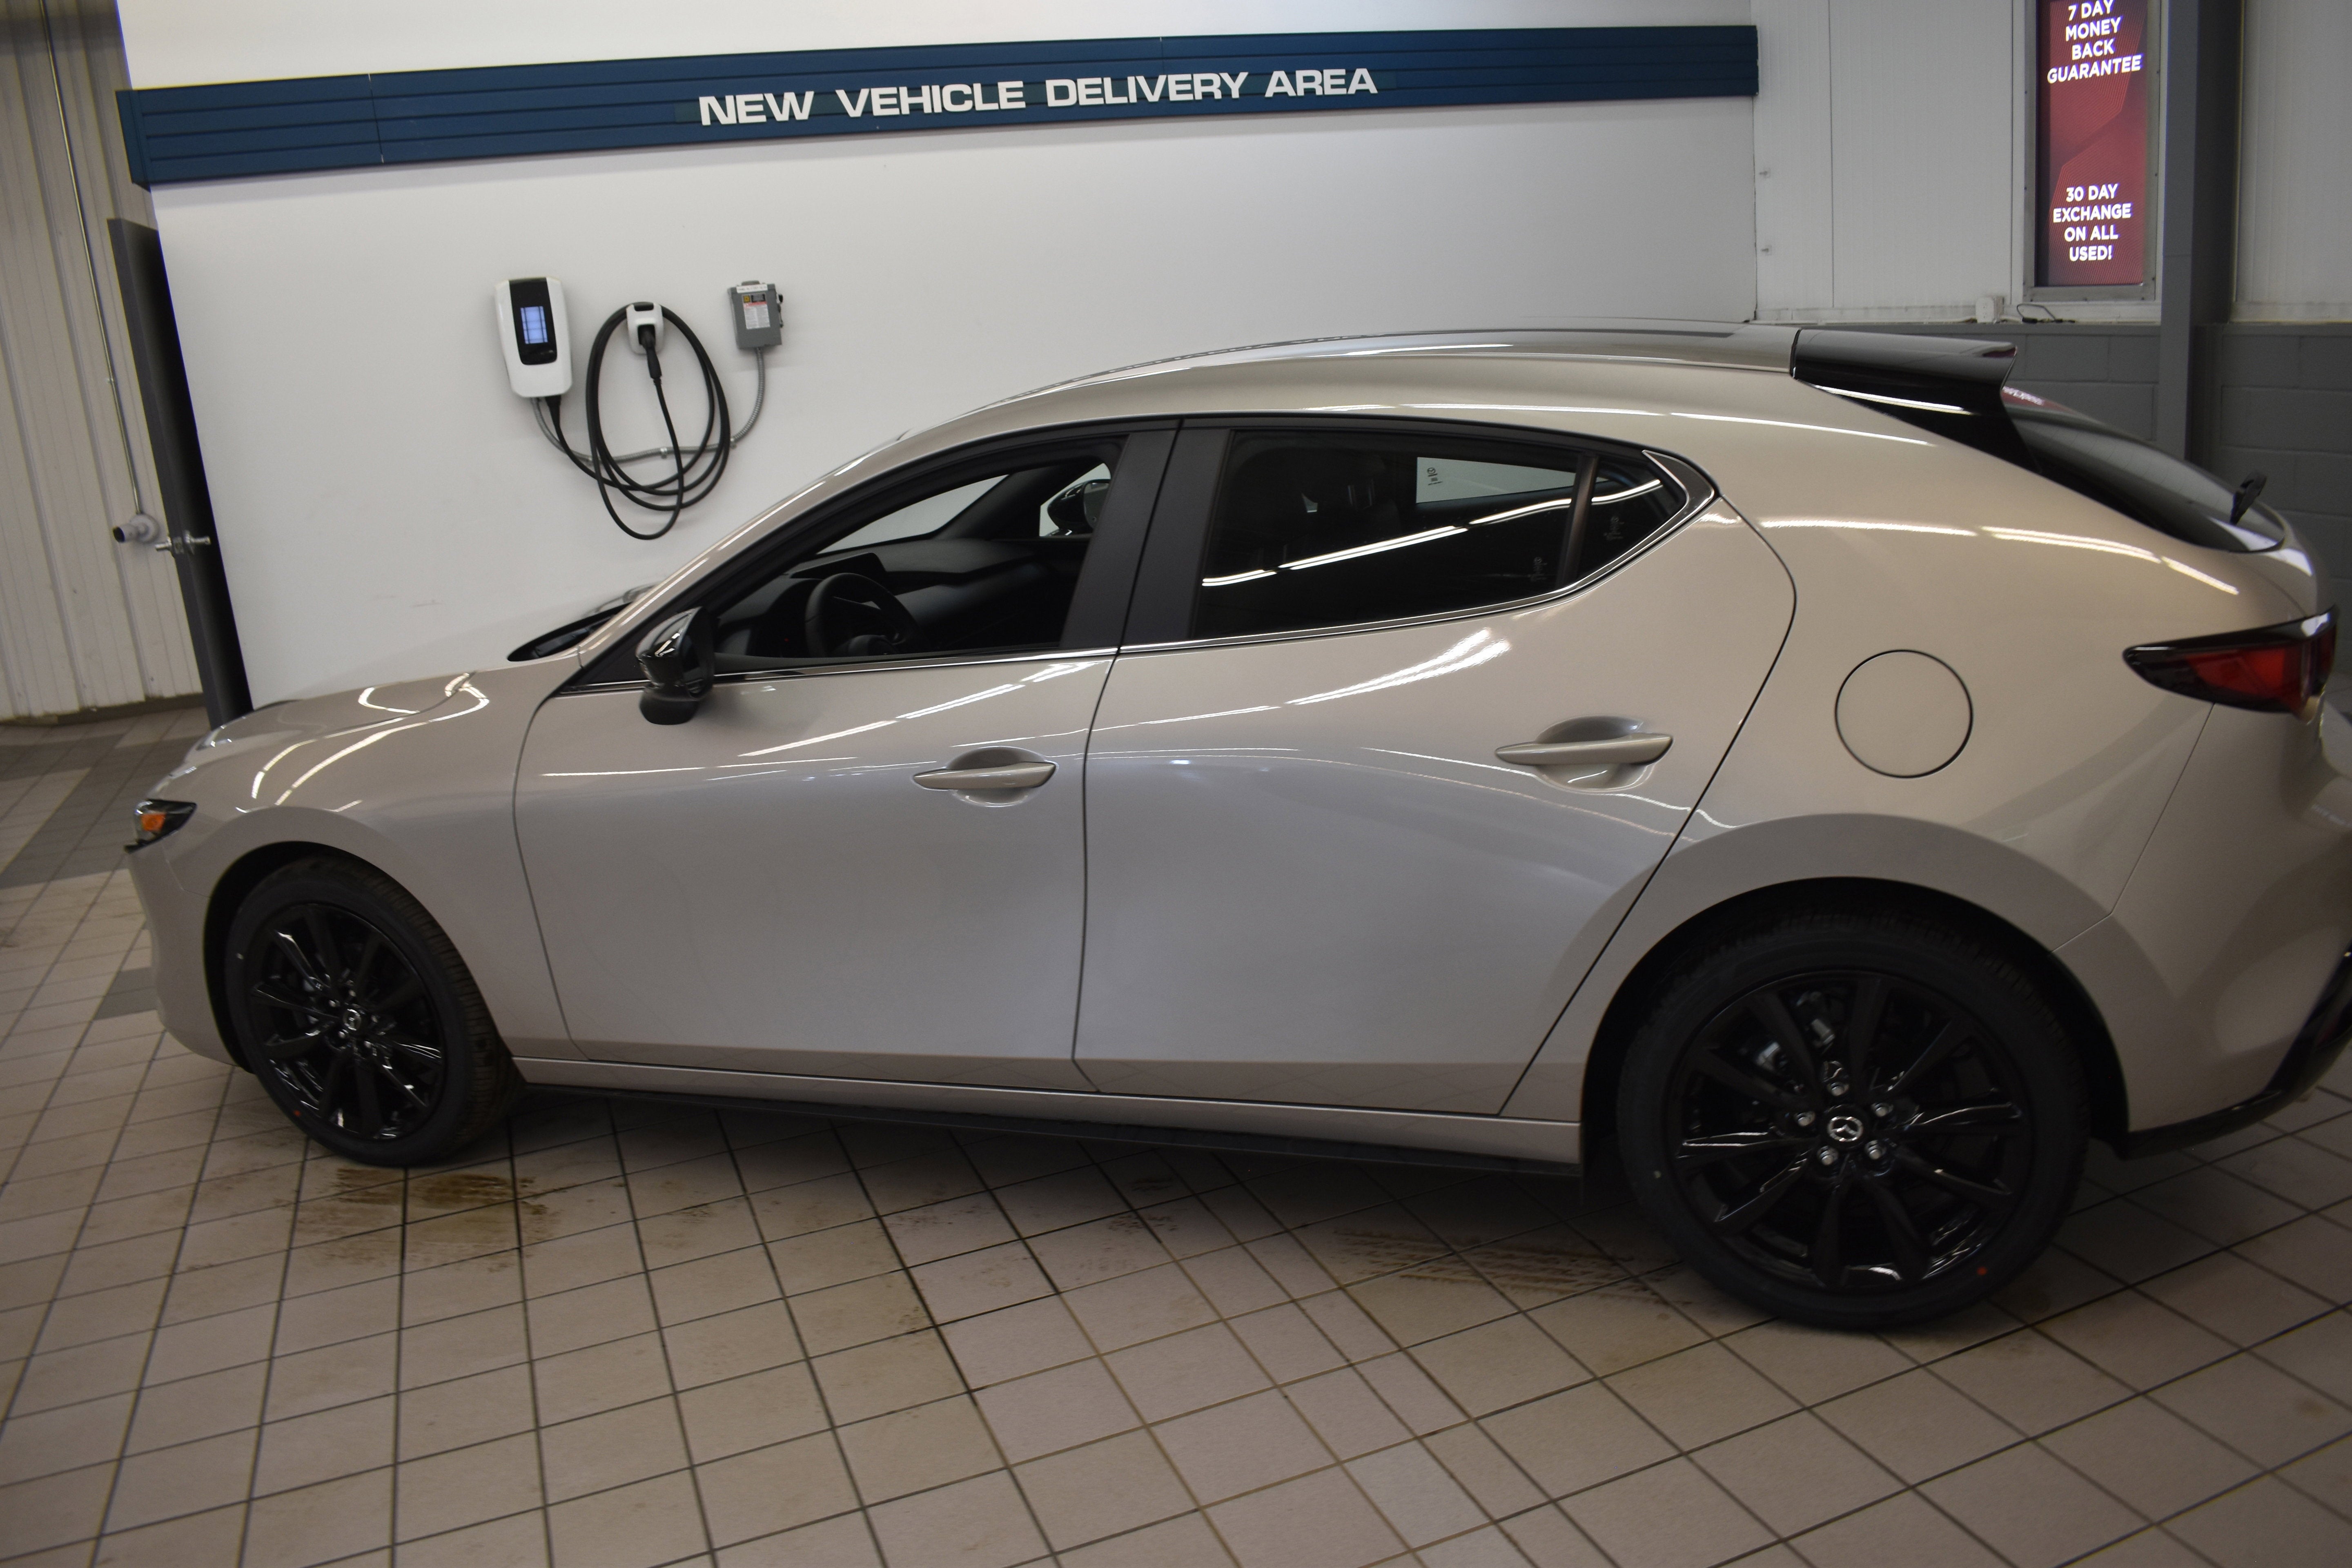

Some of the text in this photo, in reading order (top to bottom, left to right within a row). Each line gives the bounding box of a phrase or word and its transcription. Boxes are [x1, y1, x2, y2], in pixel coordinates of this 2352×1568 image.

[2068, 0, 2114, 21] 7 DAY
[2066, 17, 2121, 41] MONEY
[2072, 39, 2114, 60] BACK
[2047, 54, 2142, 84] GUARANTEE
[699, 68, 1378, 126] NEW VEHICLE DELIVERY AREA
[2066, 183, 2118, 202] 30 DAY
[2053, 203, 2132, 223] EXCHANGE
[2064, 224, 2119, 242] ON ALL
[2069, 245, 2112, 262] USED!
